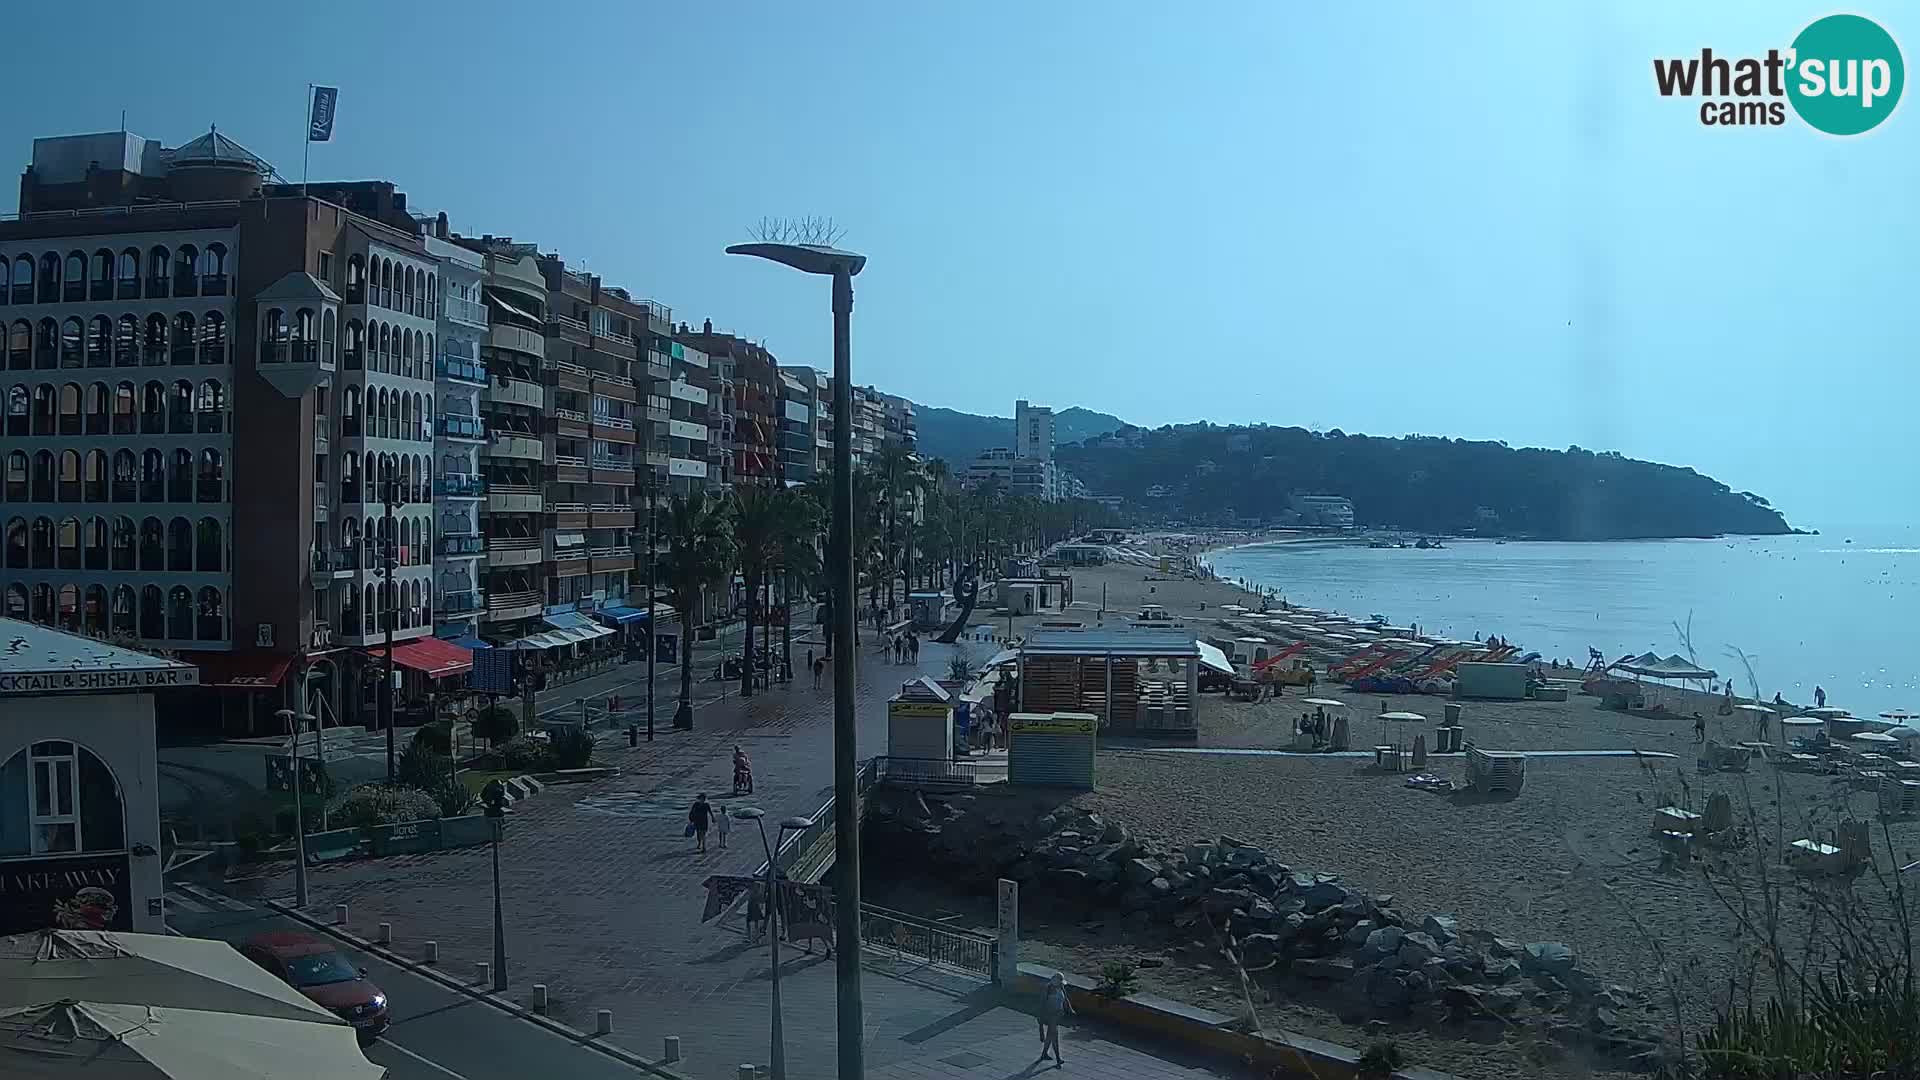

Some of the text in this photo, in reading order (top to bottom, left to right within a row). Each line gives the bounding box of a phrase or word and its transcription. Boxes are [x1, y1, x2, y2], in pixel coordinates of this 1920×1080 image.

[312, 629, 332, 647] KFC
[63, 673, 74, 688] &
[79, 671, 141, 688] SHISHA
[145, 670, 178, 685] BAR
[230, 676, 267, 684] KFC
